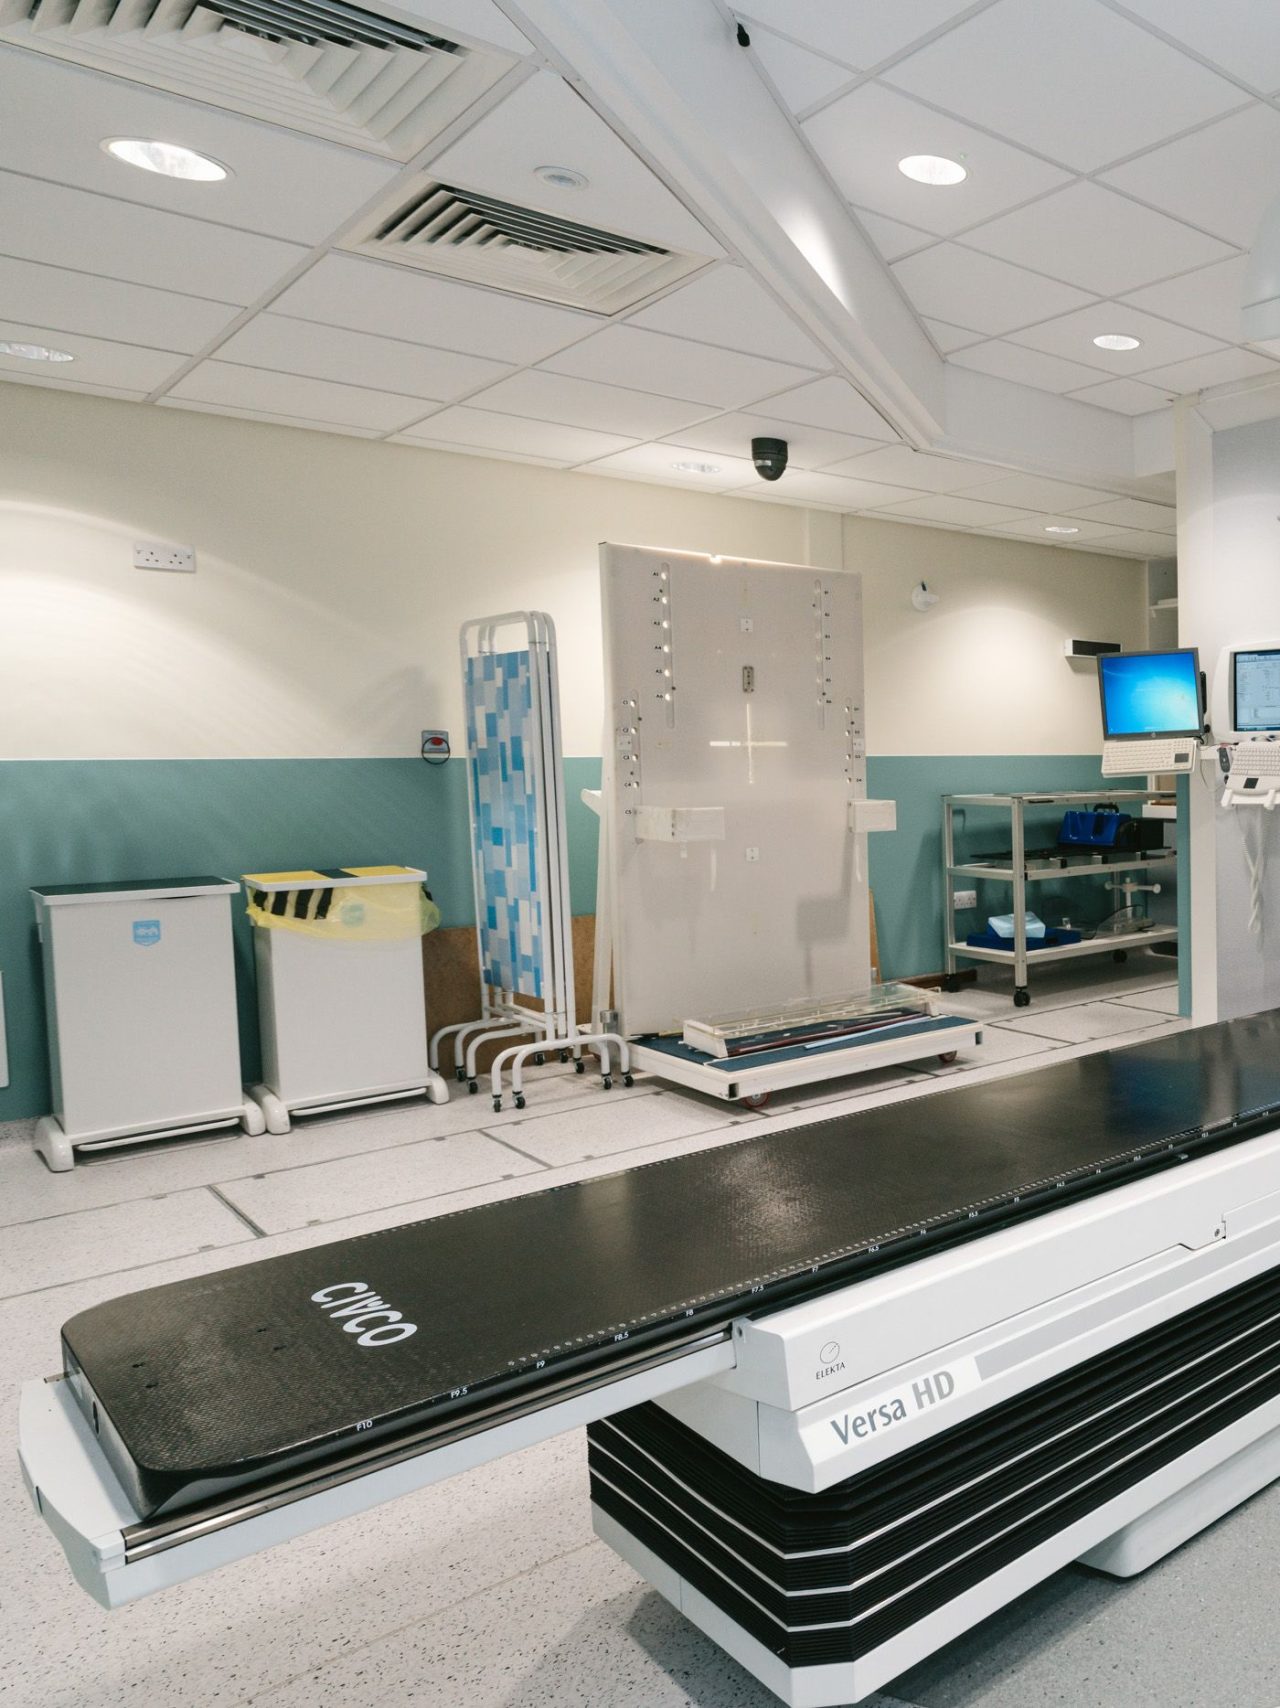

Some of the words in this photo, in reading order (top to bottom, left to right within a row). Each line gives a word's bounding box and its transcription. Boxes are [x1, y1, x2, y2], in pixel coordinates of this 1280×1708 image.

[751, 1285, 764, 1293] F7.5
[310, 1282, 418, 1347] CIVCO
[614, 1331, 629, 1342] F8.5
[536, 1360, 546, 1369] F9
[815, 1361, 846, 1380] ELEKTA
[450, 1387, 468, 1399] F9.5
[830, 1398, 907, 1446] Versa
[912, 1370, 955, 1410] HD
[356, 1420, 373, 1432] F10
